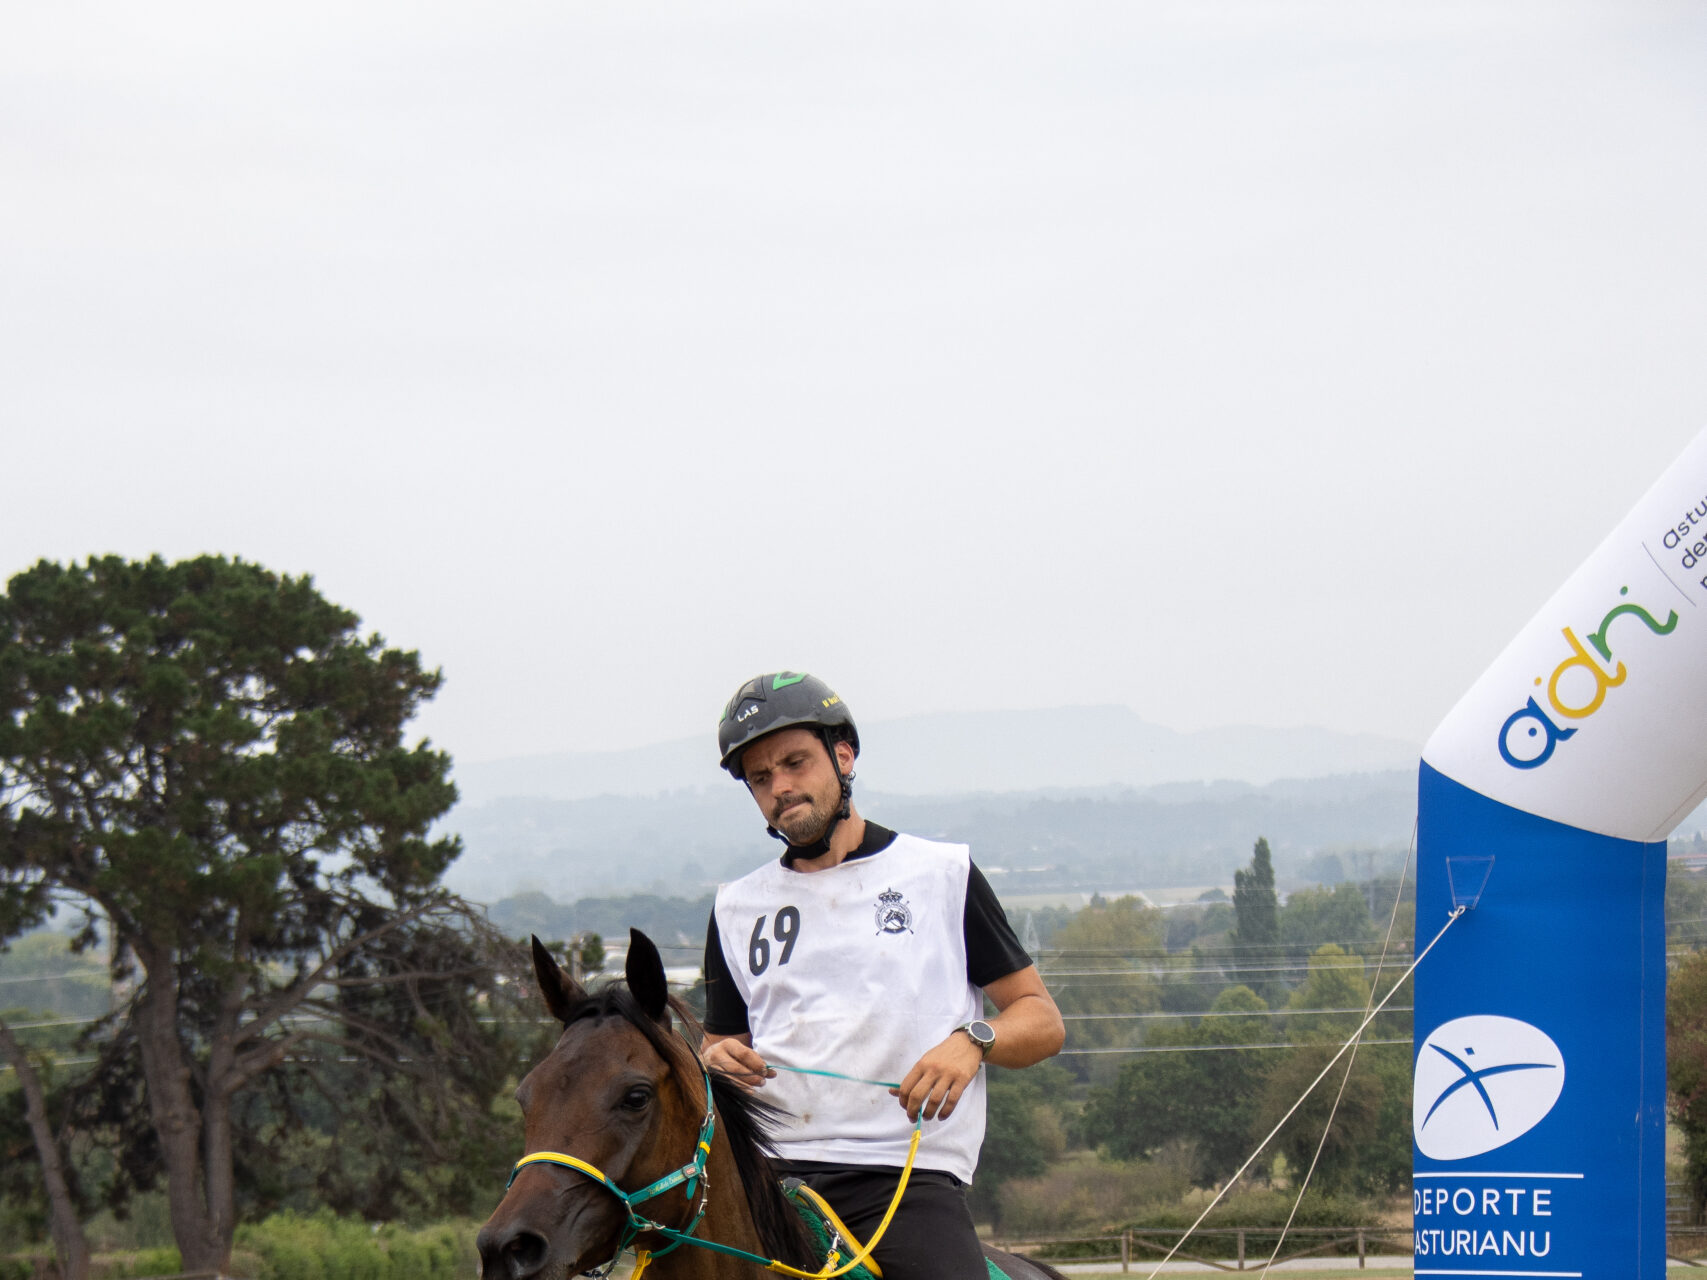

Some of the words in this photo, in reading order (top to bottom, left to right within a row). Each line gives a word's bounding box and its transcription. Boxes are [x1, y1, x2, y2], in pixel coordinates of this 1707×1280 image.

[1663, 496, 1707, 549] astu
[1682, 533, 1707, 569] de
[737, 705, 759, 722] LAS
[749, 905, 801, 977] 69
[1414, 1188, 1552, 1216] DEPORTE
[1415, 1229, 1551, 1257] ASTURIANU
